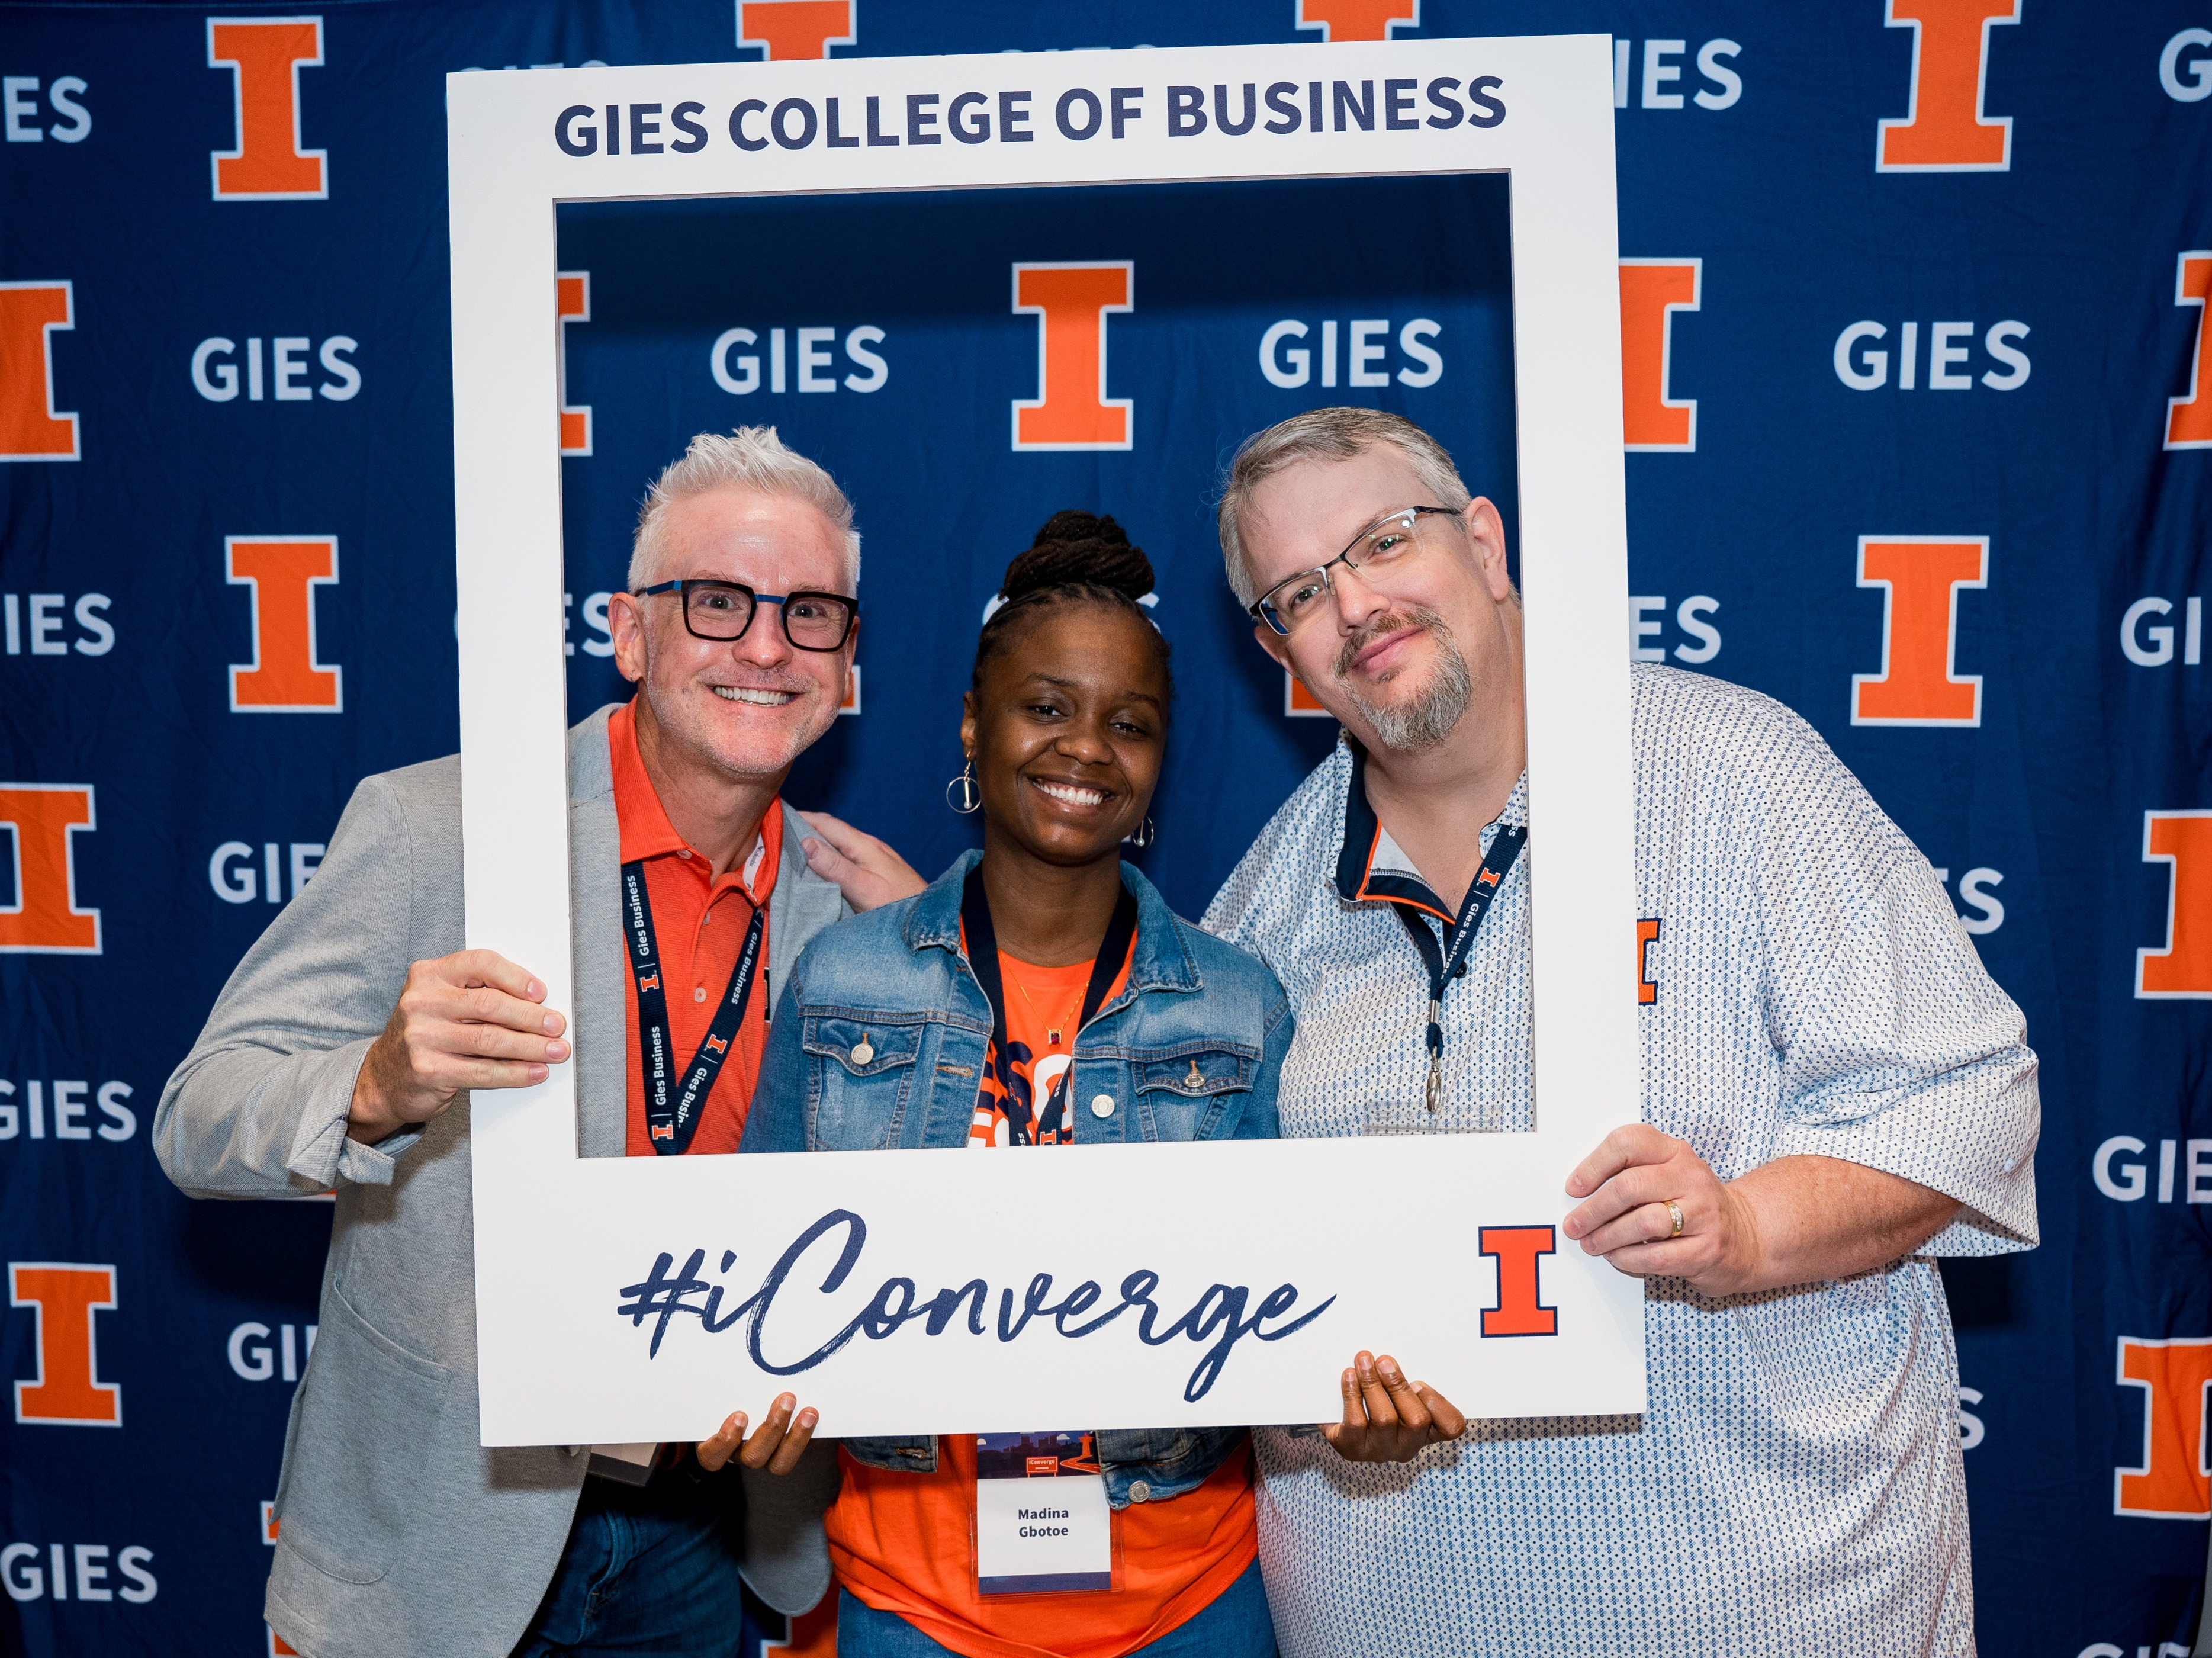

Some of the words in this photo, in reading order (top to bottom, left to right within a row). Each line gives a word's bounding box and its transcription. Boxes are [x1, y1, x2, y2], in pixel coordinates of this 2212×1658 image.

[555, 101, 708, 158] GIES
[728, 91, 1034, 152] COLLEGE
[1055, 86, 1144, 141] OF
[1167, 75, 1506, 137] BUSINESS
[191, 335, 362, 402] GIES
[710, 324, 889, 396] GIES
[1259, 318, 1443, 390] GIES
[1833, 320, 2031, 391] GIES
[627, 875, 645, 928] Business
[1462, 902, 1479, 928] Gies
[639, 930, 650, 956] Gies
[747, 931, 758, 956] Gies
[731, 956, 752, 1005] Business
[651, 1026, 665, 1078] Business
[654, 1079, 667, 1106] Gies
[689, 1067, 708, 1091] Gies
[677, 1091, 696, 1128] Busin
[617, 1207, 1337, 1403] #iConverge
[1018, 1507, 1069, 1520] Madina
[1019, 1525, 1069, 1538] Gbotoe
[0, 1543, 158, 1604] GIES
